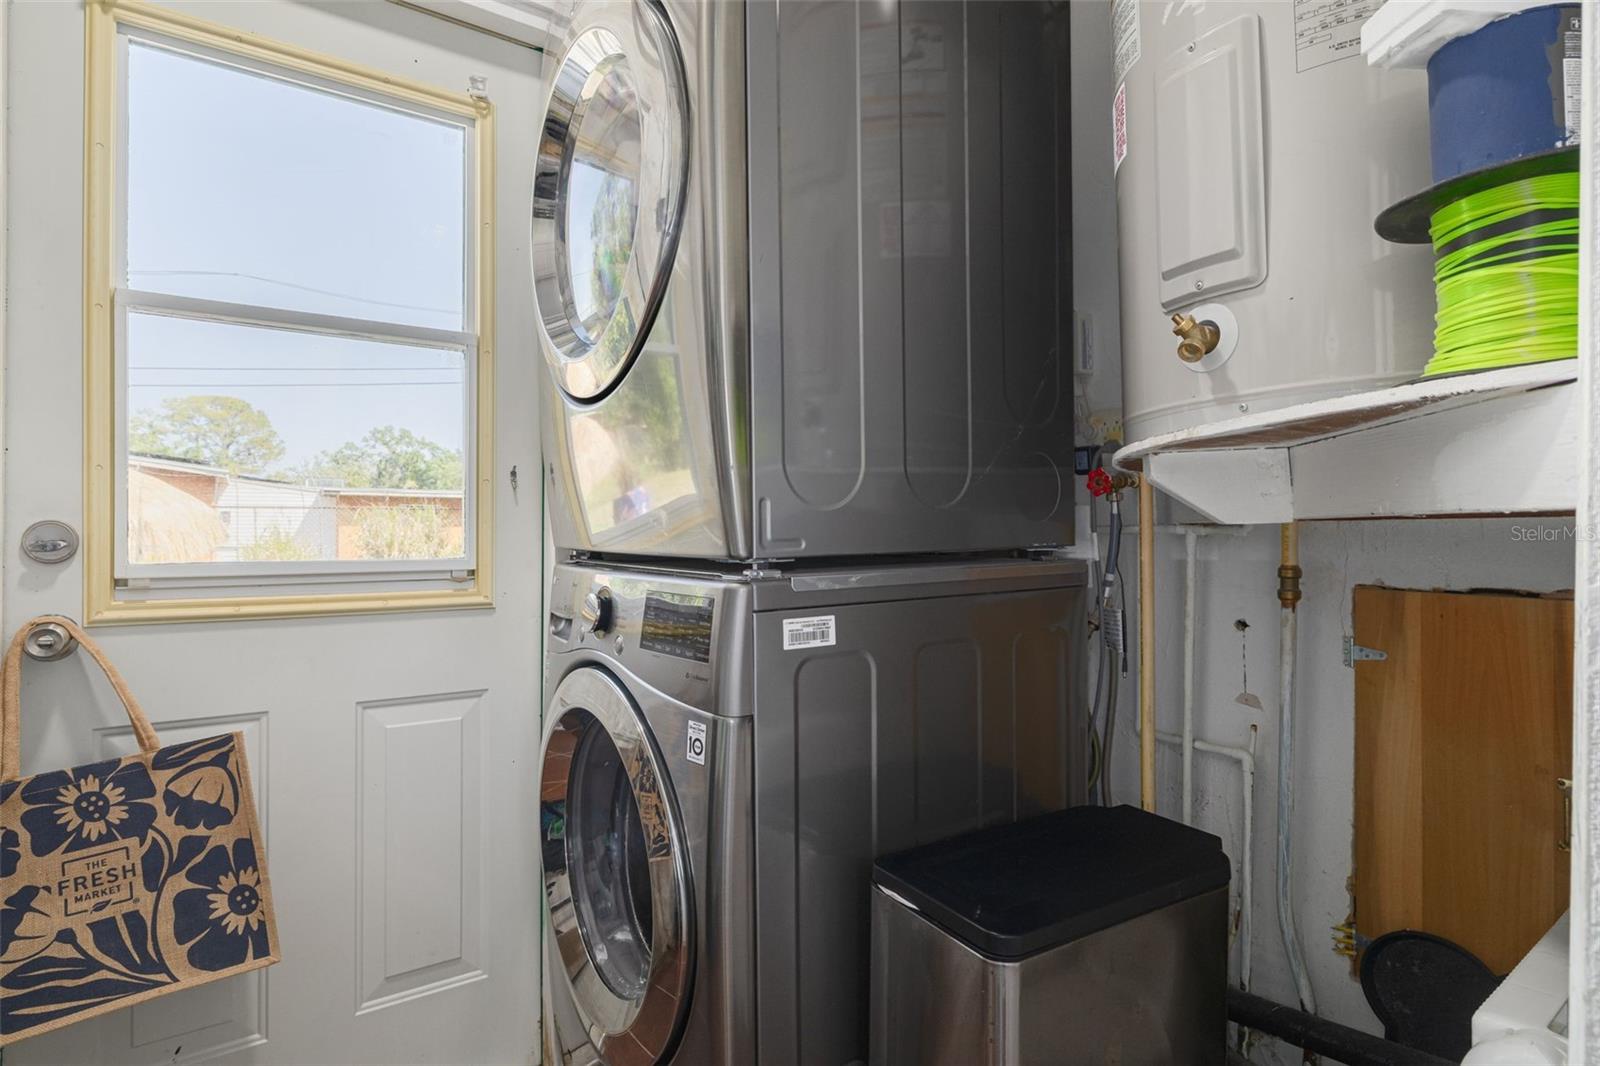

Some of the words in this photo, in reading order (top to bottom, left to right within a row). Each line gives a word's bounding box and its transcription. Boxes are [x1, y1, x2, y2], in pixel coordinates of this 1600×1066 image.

[689, 736, 704, 756] 10
[85, 858, 108, 871] THE
[58, 862, 136, 896] FRESH
[74, 885, 121, 903] MARKET
